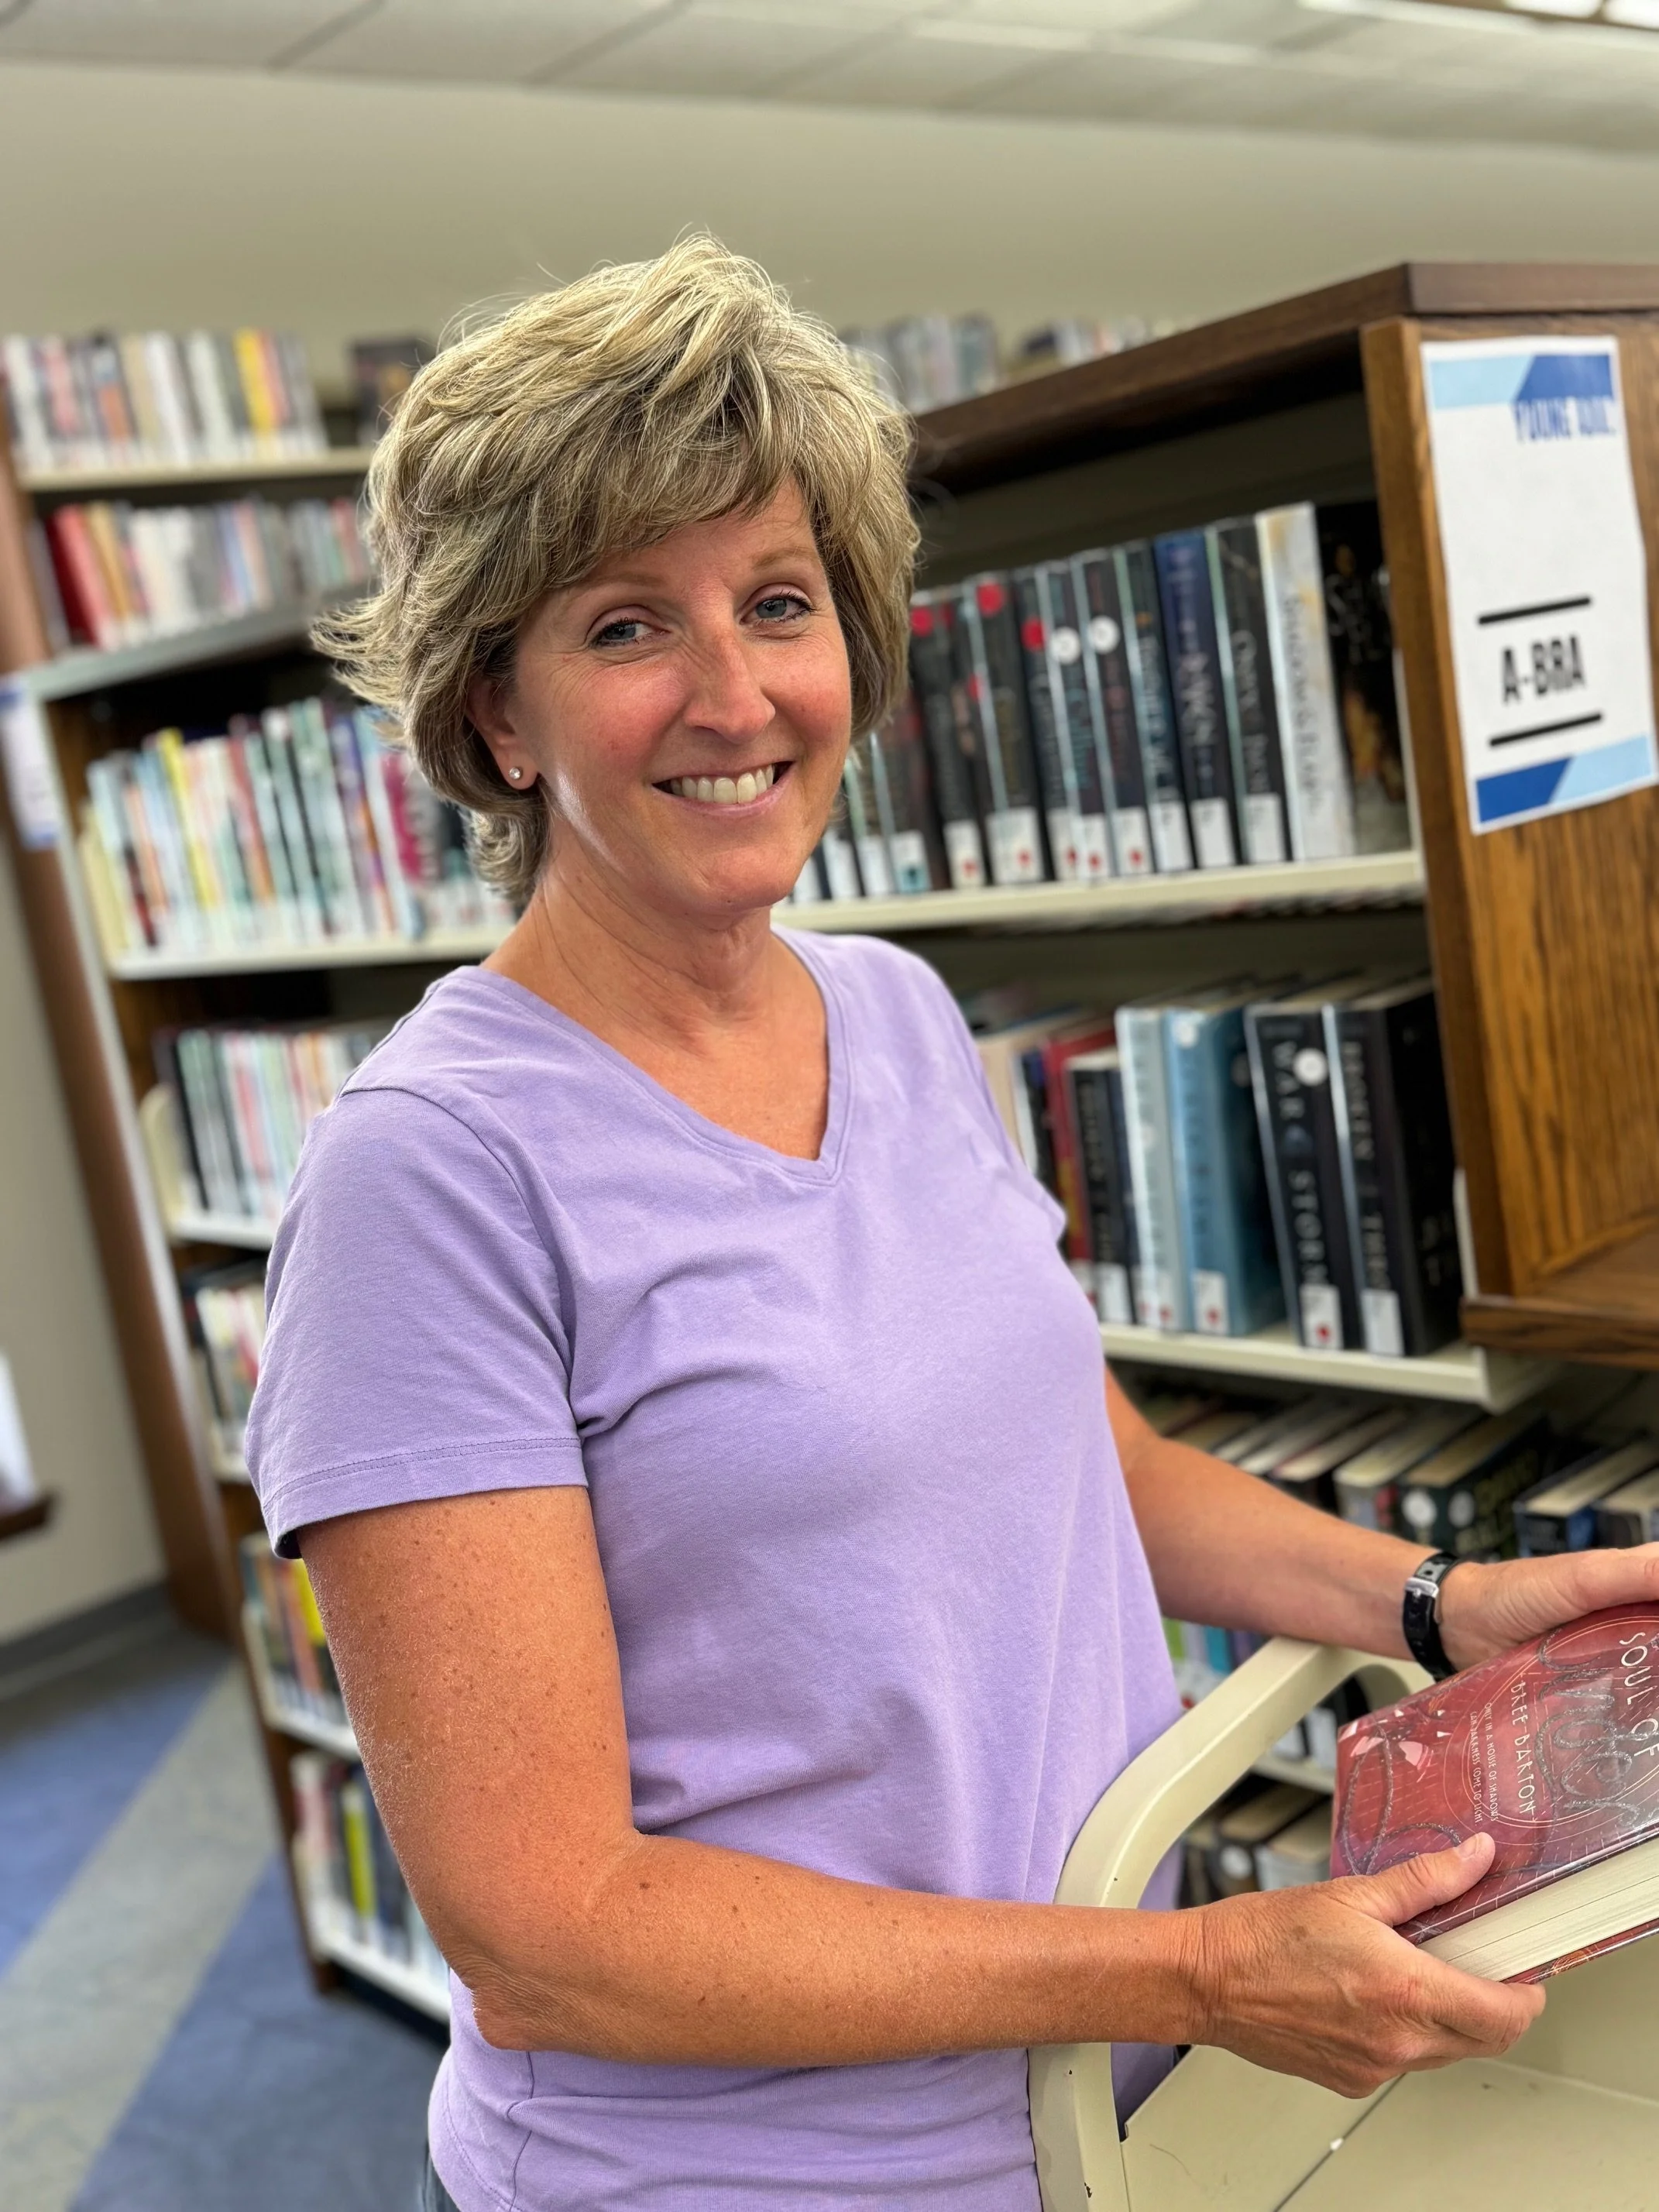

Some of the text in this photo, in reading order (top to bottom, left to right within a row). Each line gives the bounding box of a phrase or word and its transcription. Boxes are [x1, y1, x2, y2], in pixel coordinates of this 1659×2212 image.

[1502, 634, 1586, 704] A-BRA
[1619, 1632, 1657, 1705] SOUL
[1484, 1702, 1492, 1719] ONLY
[1485, 1723, 1493, 1732] IN
[1486, 1742, 1496, 1768] HOUSE
[1510, 1681, 1537, 1814] BREE BARTON
[1472, 1768, 1482, 1788] COME
[1488, 1771, 1497, 1781] OF
[1473, 1788, 1482, 1800] TO
[1489, 1784, 1499, 1822] SHADOWS
